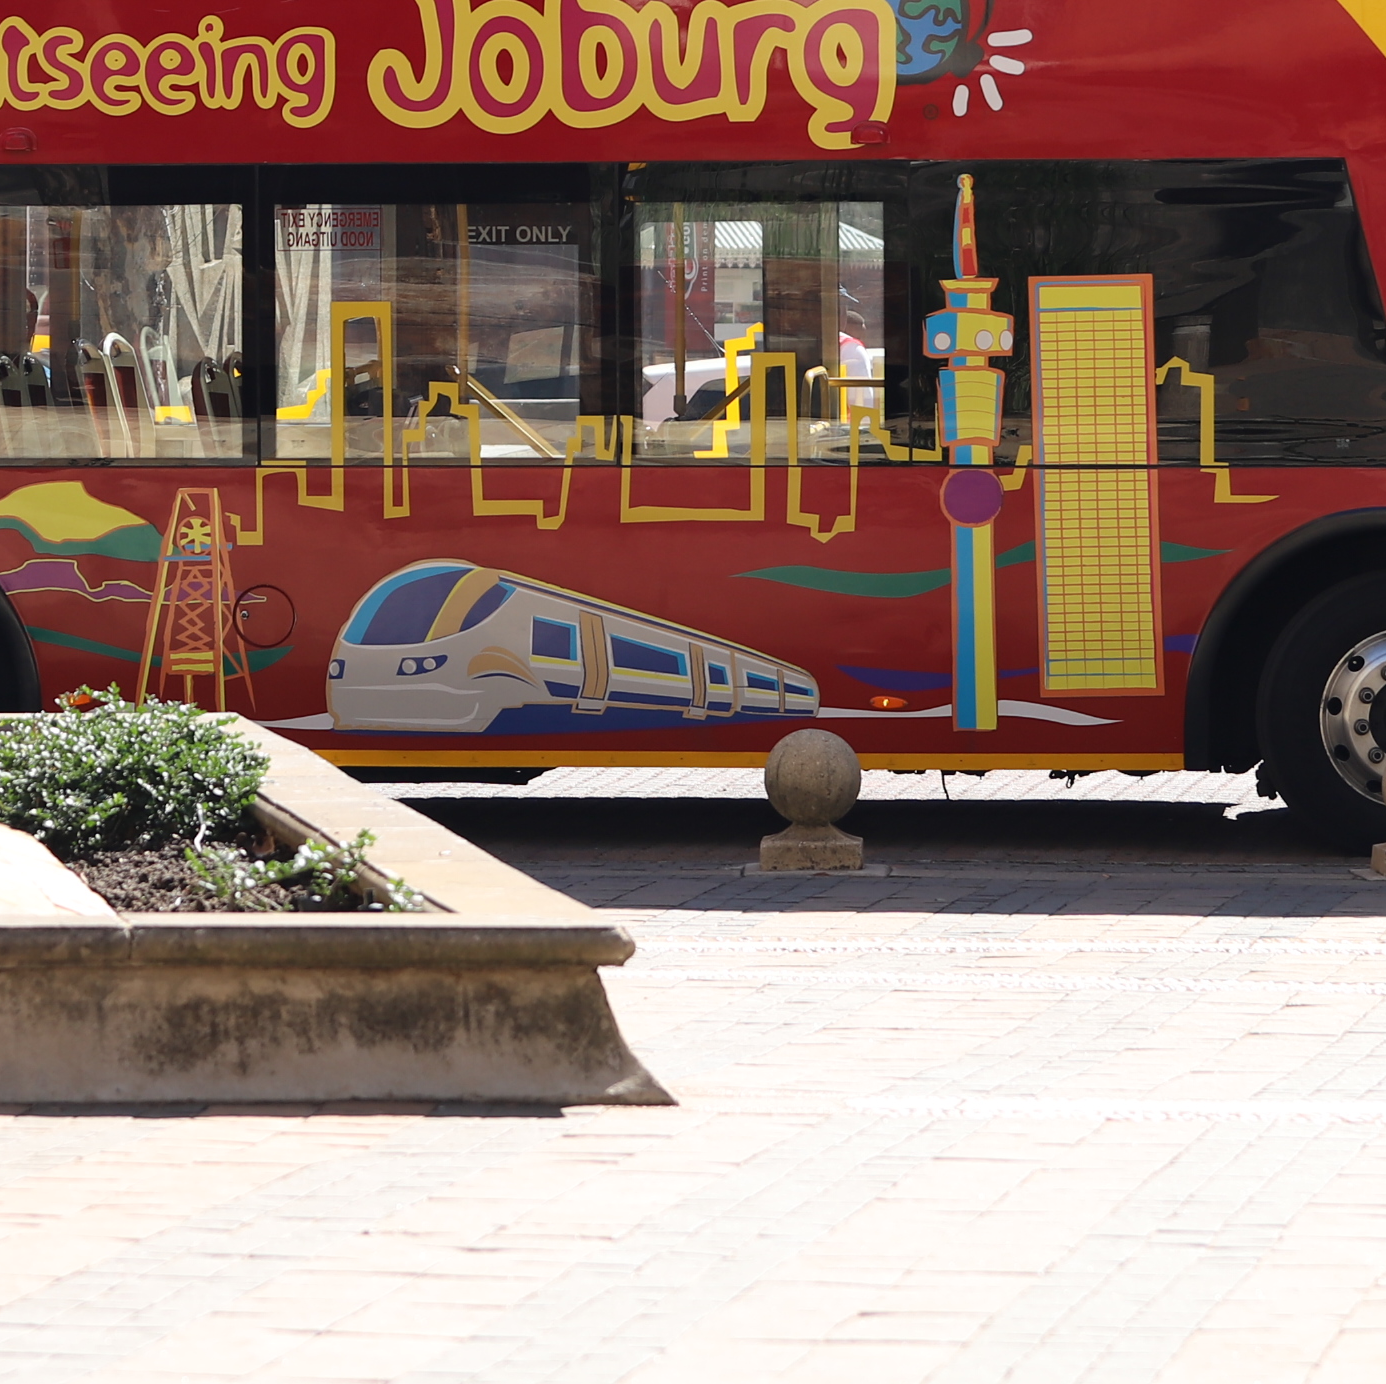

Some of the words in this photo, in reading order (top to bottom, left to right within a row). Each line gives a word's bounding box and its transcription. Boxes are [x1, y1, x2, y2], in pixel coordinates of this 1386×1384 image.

[467, 225, 510, 242] EXIT
[515, 225, 572, 243] ONLY
[702, 248, 709, 261] on
[700, 266, 709, 292] Print
